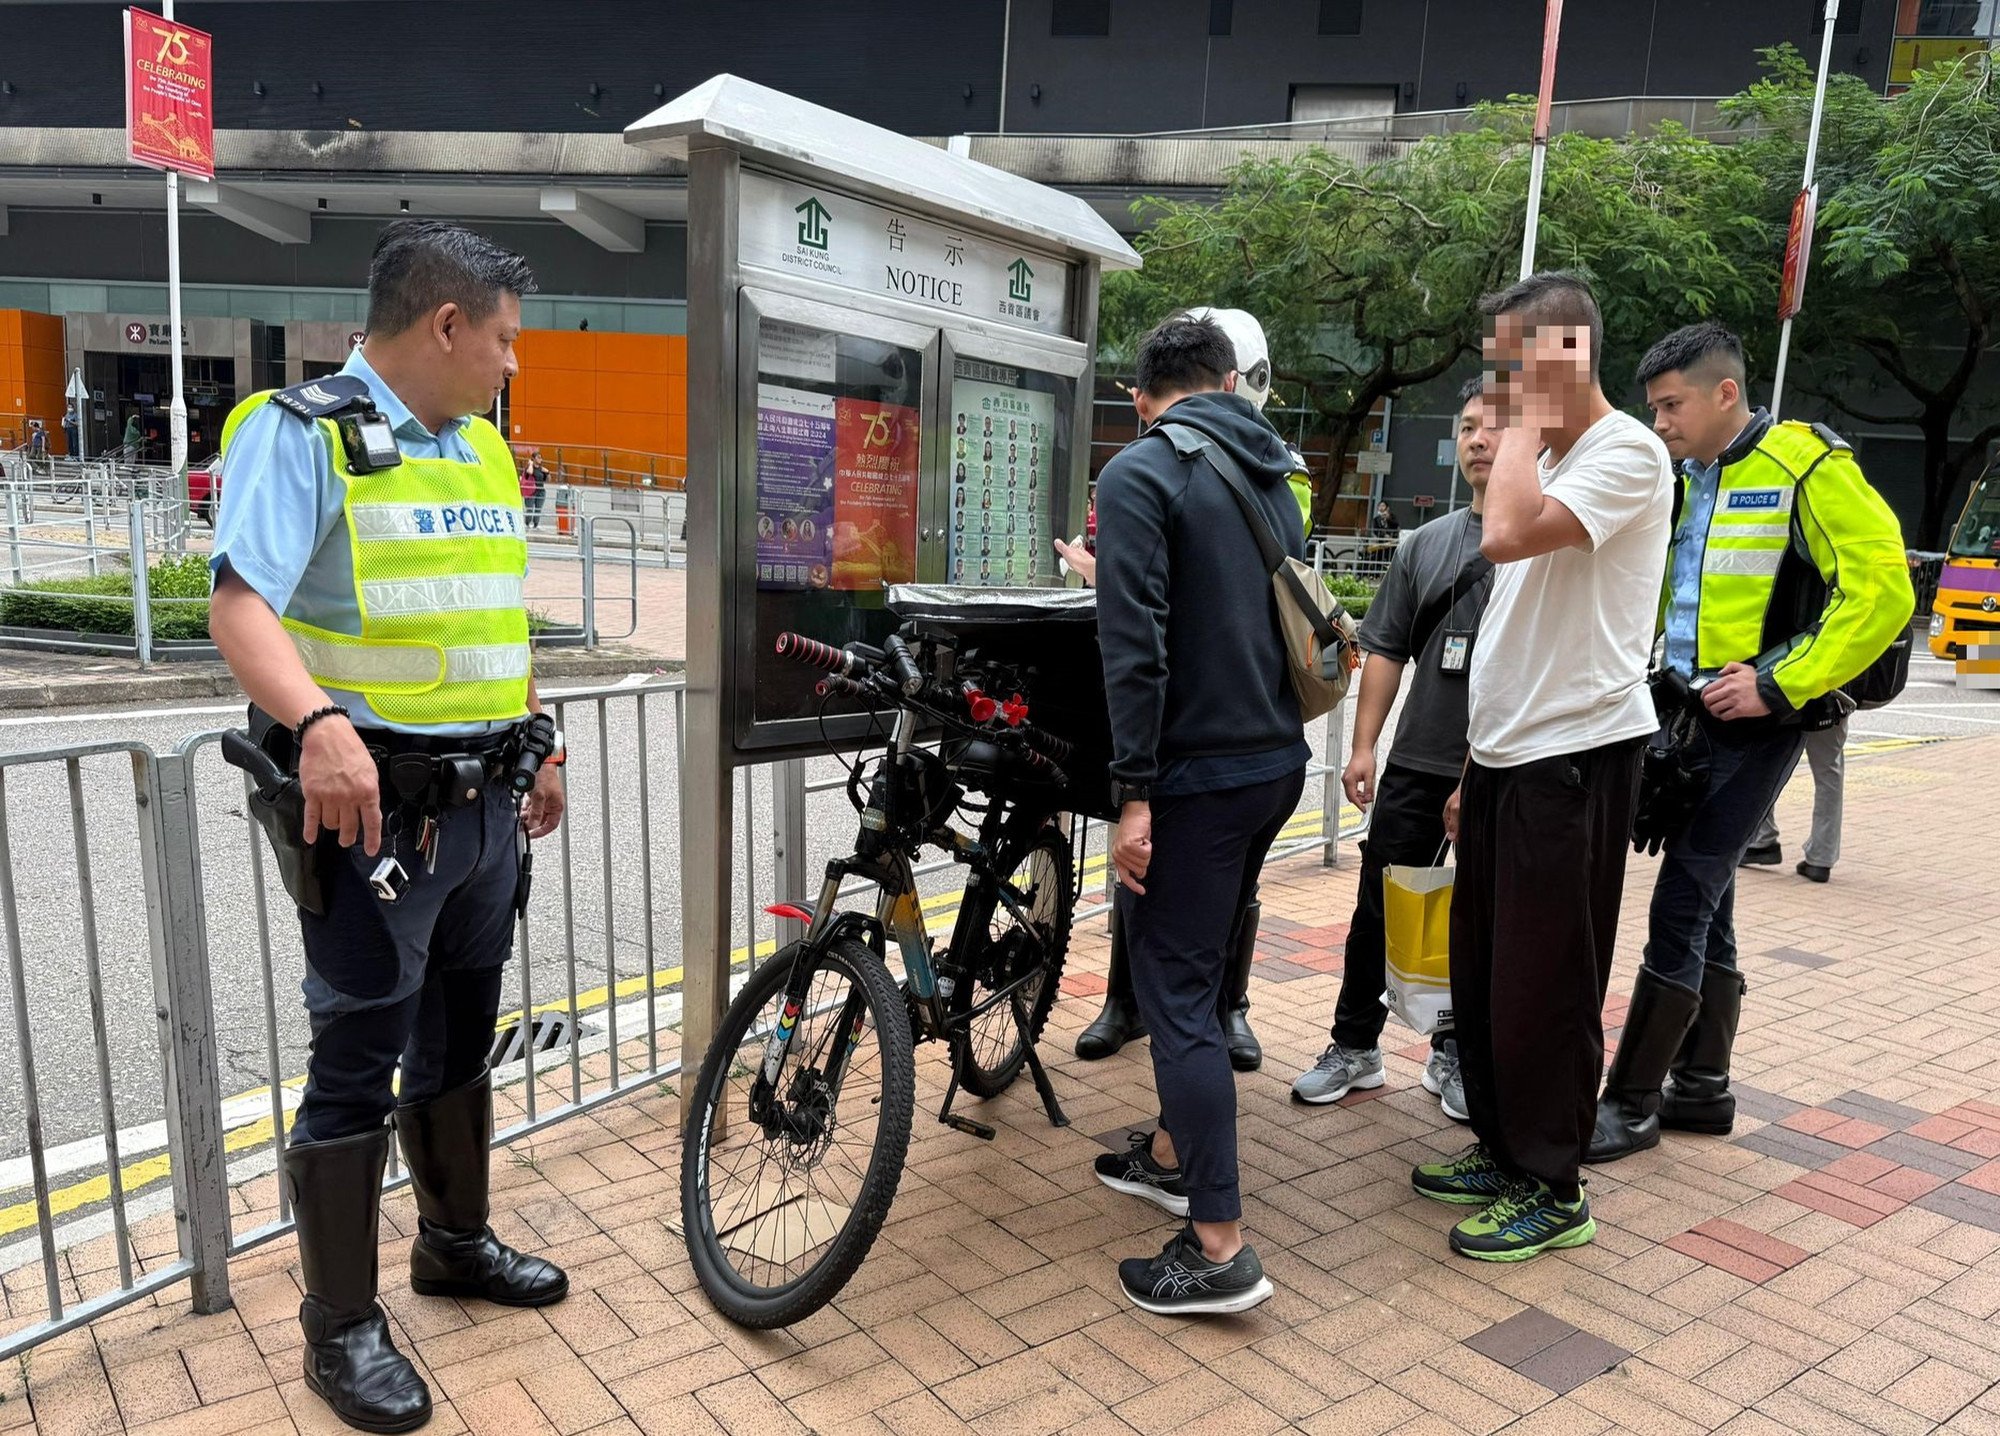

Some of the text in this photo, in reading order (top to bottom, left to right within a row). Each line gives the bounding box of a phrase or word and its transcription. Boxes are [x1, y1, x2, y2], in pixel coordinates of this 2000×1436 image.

[152, 26, 192, 66] 75
[136, 58, 206, 91] CELEBRATING
[781, 252, 843, 275] DISTRICT COUNCIL
[796, 245, 830, 262] SAI KUNG
[885, 264, 964, 307] NOTICE
[860, 411, 892, 449] 75
[850, 481, 903, 495] CELEBRATING
[1739, 494, 1769, 506] POLICE
